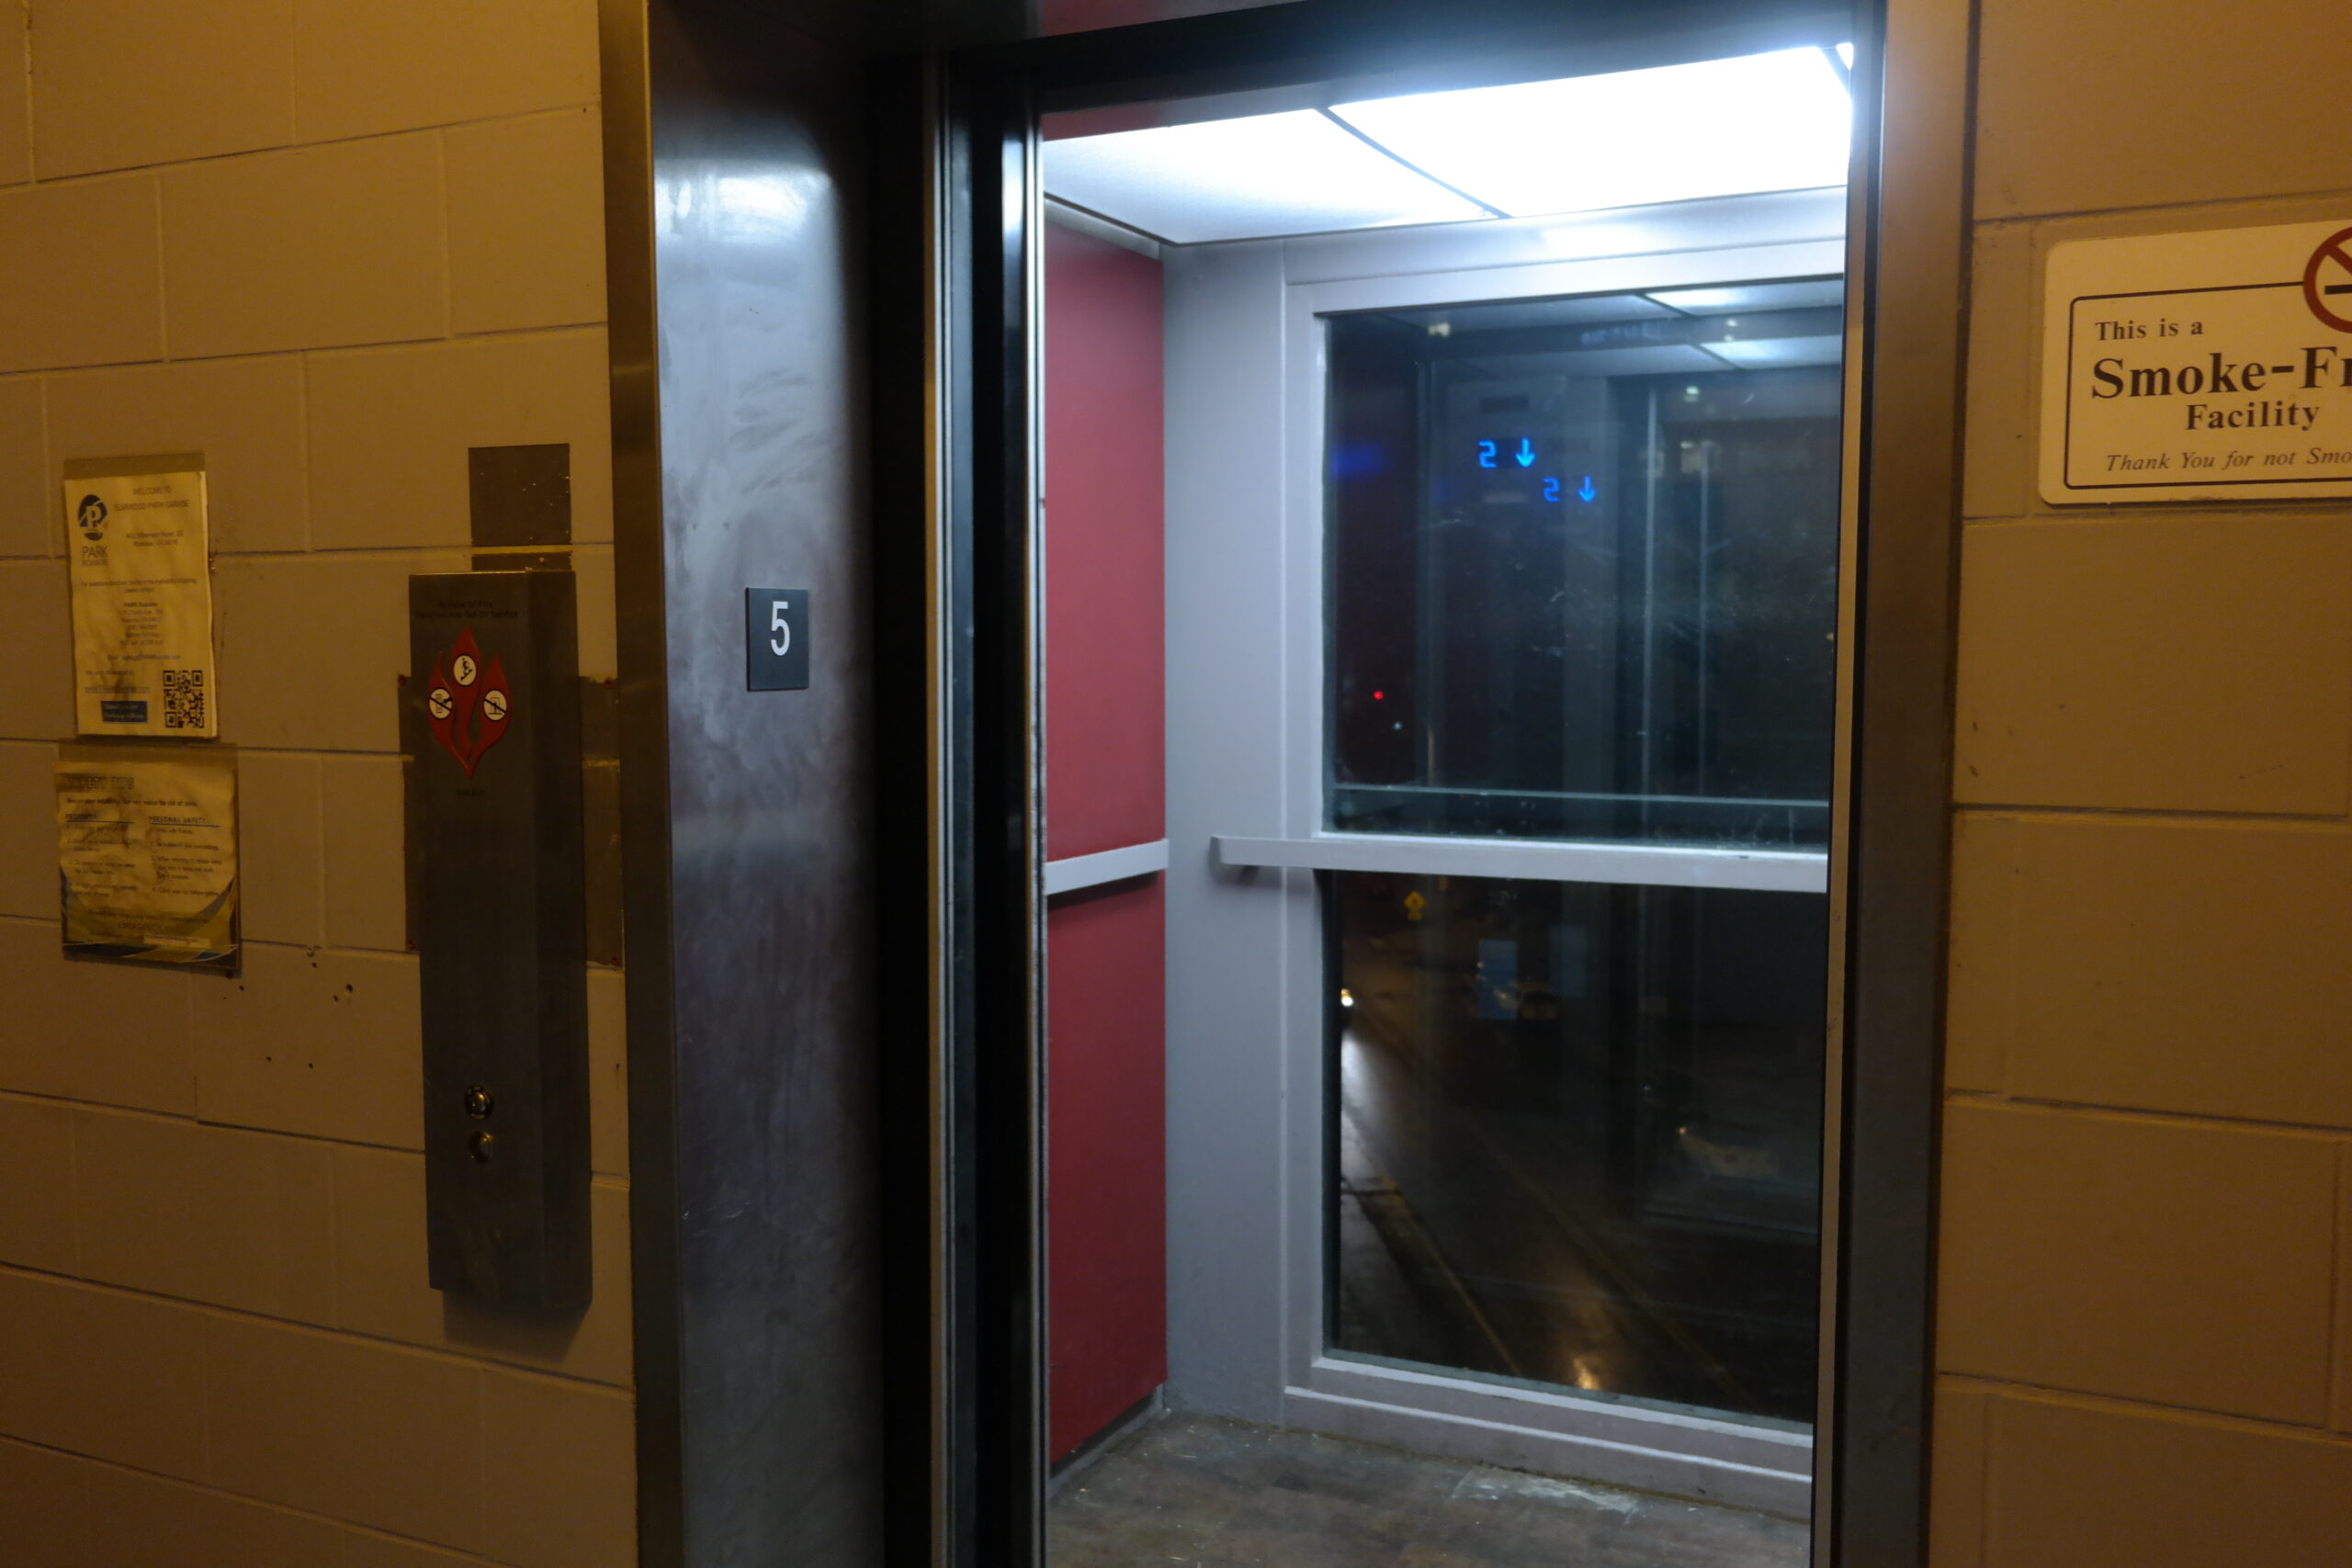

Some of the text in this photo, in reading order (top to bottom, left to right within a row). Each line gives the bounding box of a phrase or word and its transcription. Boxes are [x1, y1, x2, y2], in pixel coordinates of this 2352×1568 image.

[2094, 318, 2203, 341] This is a
[2185, 400, 2320, 431] Facility
[2107, 453, 2170, 471] Thank
[2181, 451, 2216, 469] You
[2222, 450, 2254, 470] for
[2264, 451, 2296, 466] not
[81, 546, 108, 558] PARK
[770, 601, 790, 656] 5
